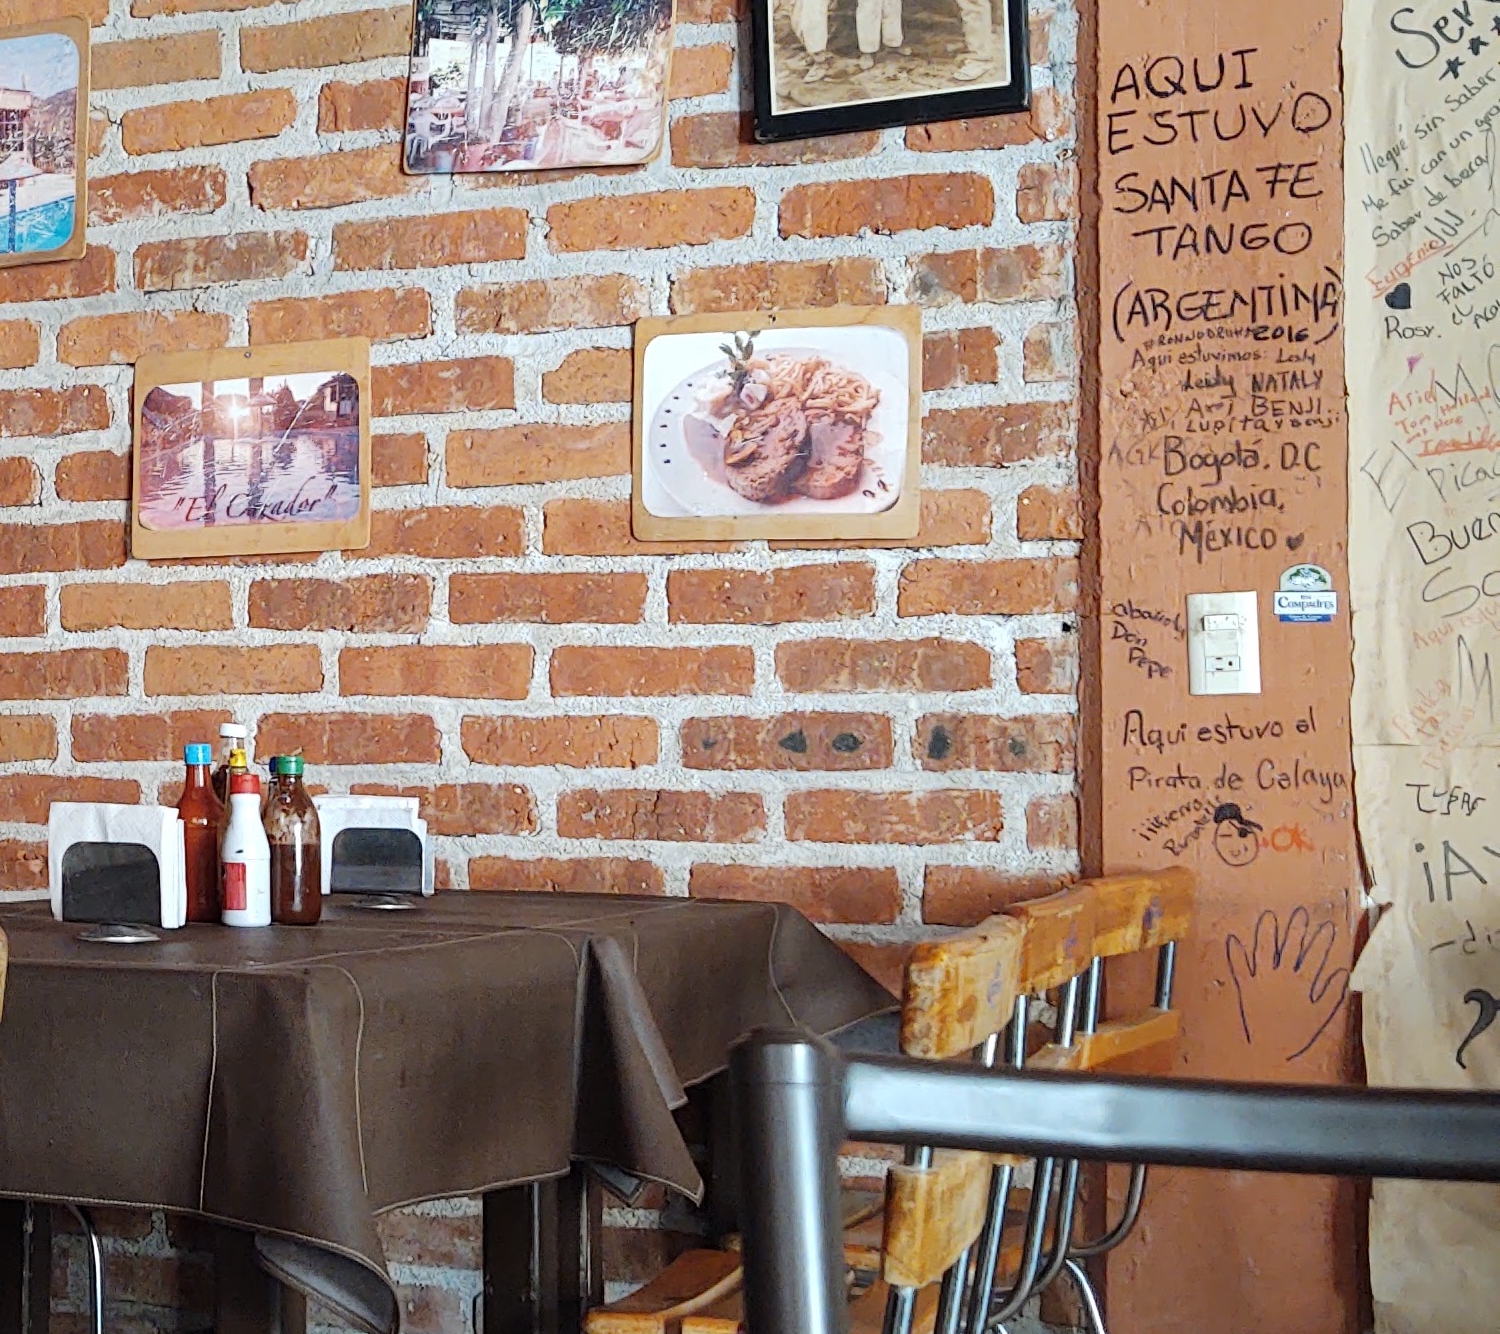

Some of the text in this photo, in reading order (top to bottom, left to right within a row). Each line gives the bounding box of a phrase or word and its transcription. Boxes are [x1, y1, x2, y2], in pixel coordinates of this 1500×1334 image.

[1111, 47, 1258, 104] AQUI
[1106, 91, 1332, 155] ESTUVO
[1112, 161, 1324, 214] SANTA FE
[1131, 221, 1313, 261] TANGO
[1252, 324, 1311, 343] 2016
[1122, 708, 1188, 755] Aqui
[1197, 712, 1284, 745] estuvo
[1213, 761, 1244, 790] de
